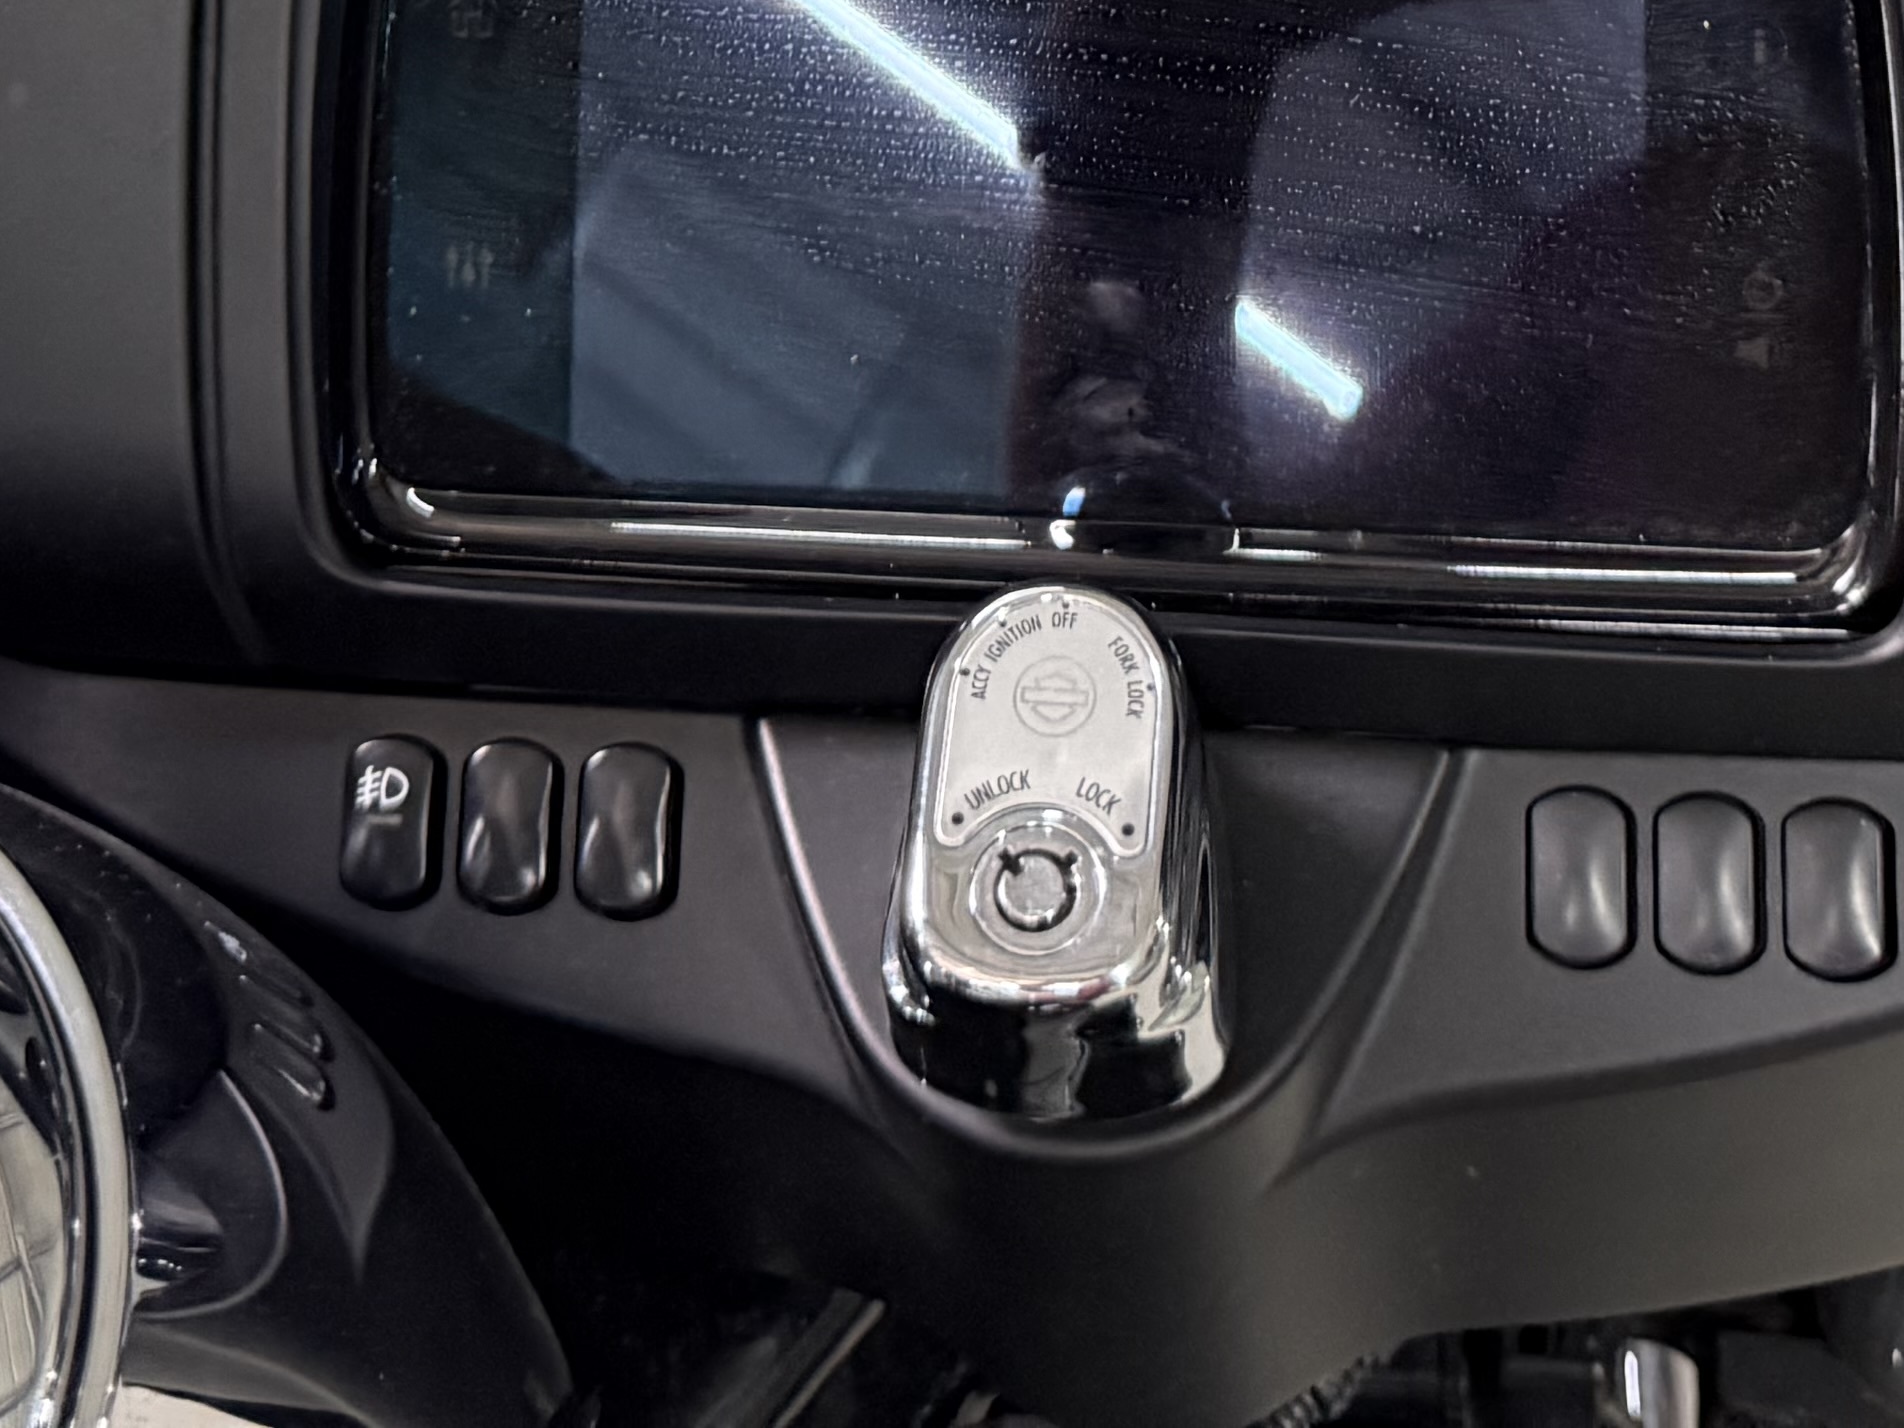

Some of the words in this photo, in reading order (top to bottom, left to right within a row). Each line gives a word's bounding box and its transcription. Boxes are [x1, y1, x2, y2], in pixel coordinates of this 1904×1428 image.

[970, 664, 991, 699] ACCY
[985, 614, 1042, 663] IGNITION
[1052, 611, 1078, 629] OFF
[1107, 636, 1140, 676] FORK
[1126, 679, 1144, 719] LOCK
[964, 769, 1031, 810] UNLOCK
[1076, 776, 1122, 816] LOCK
